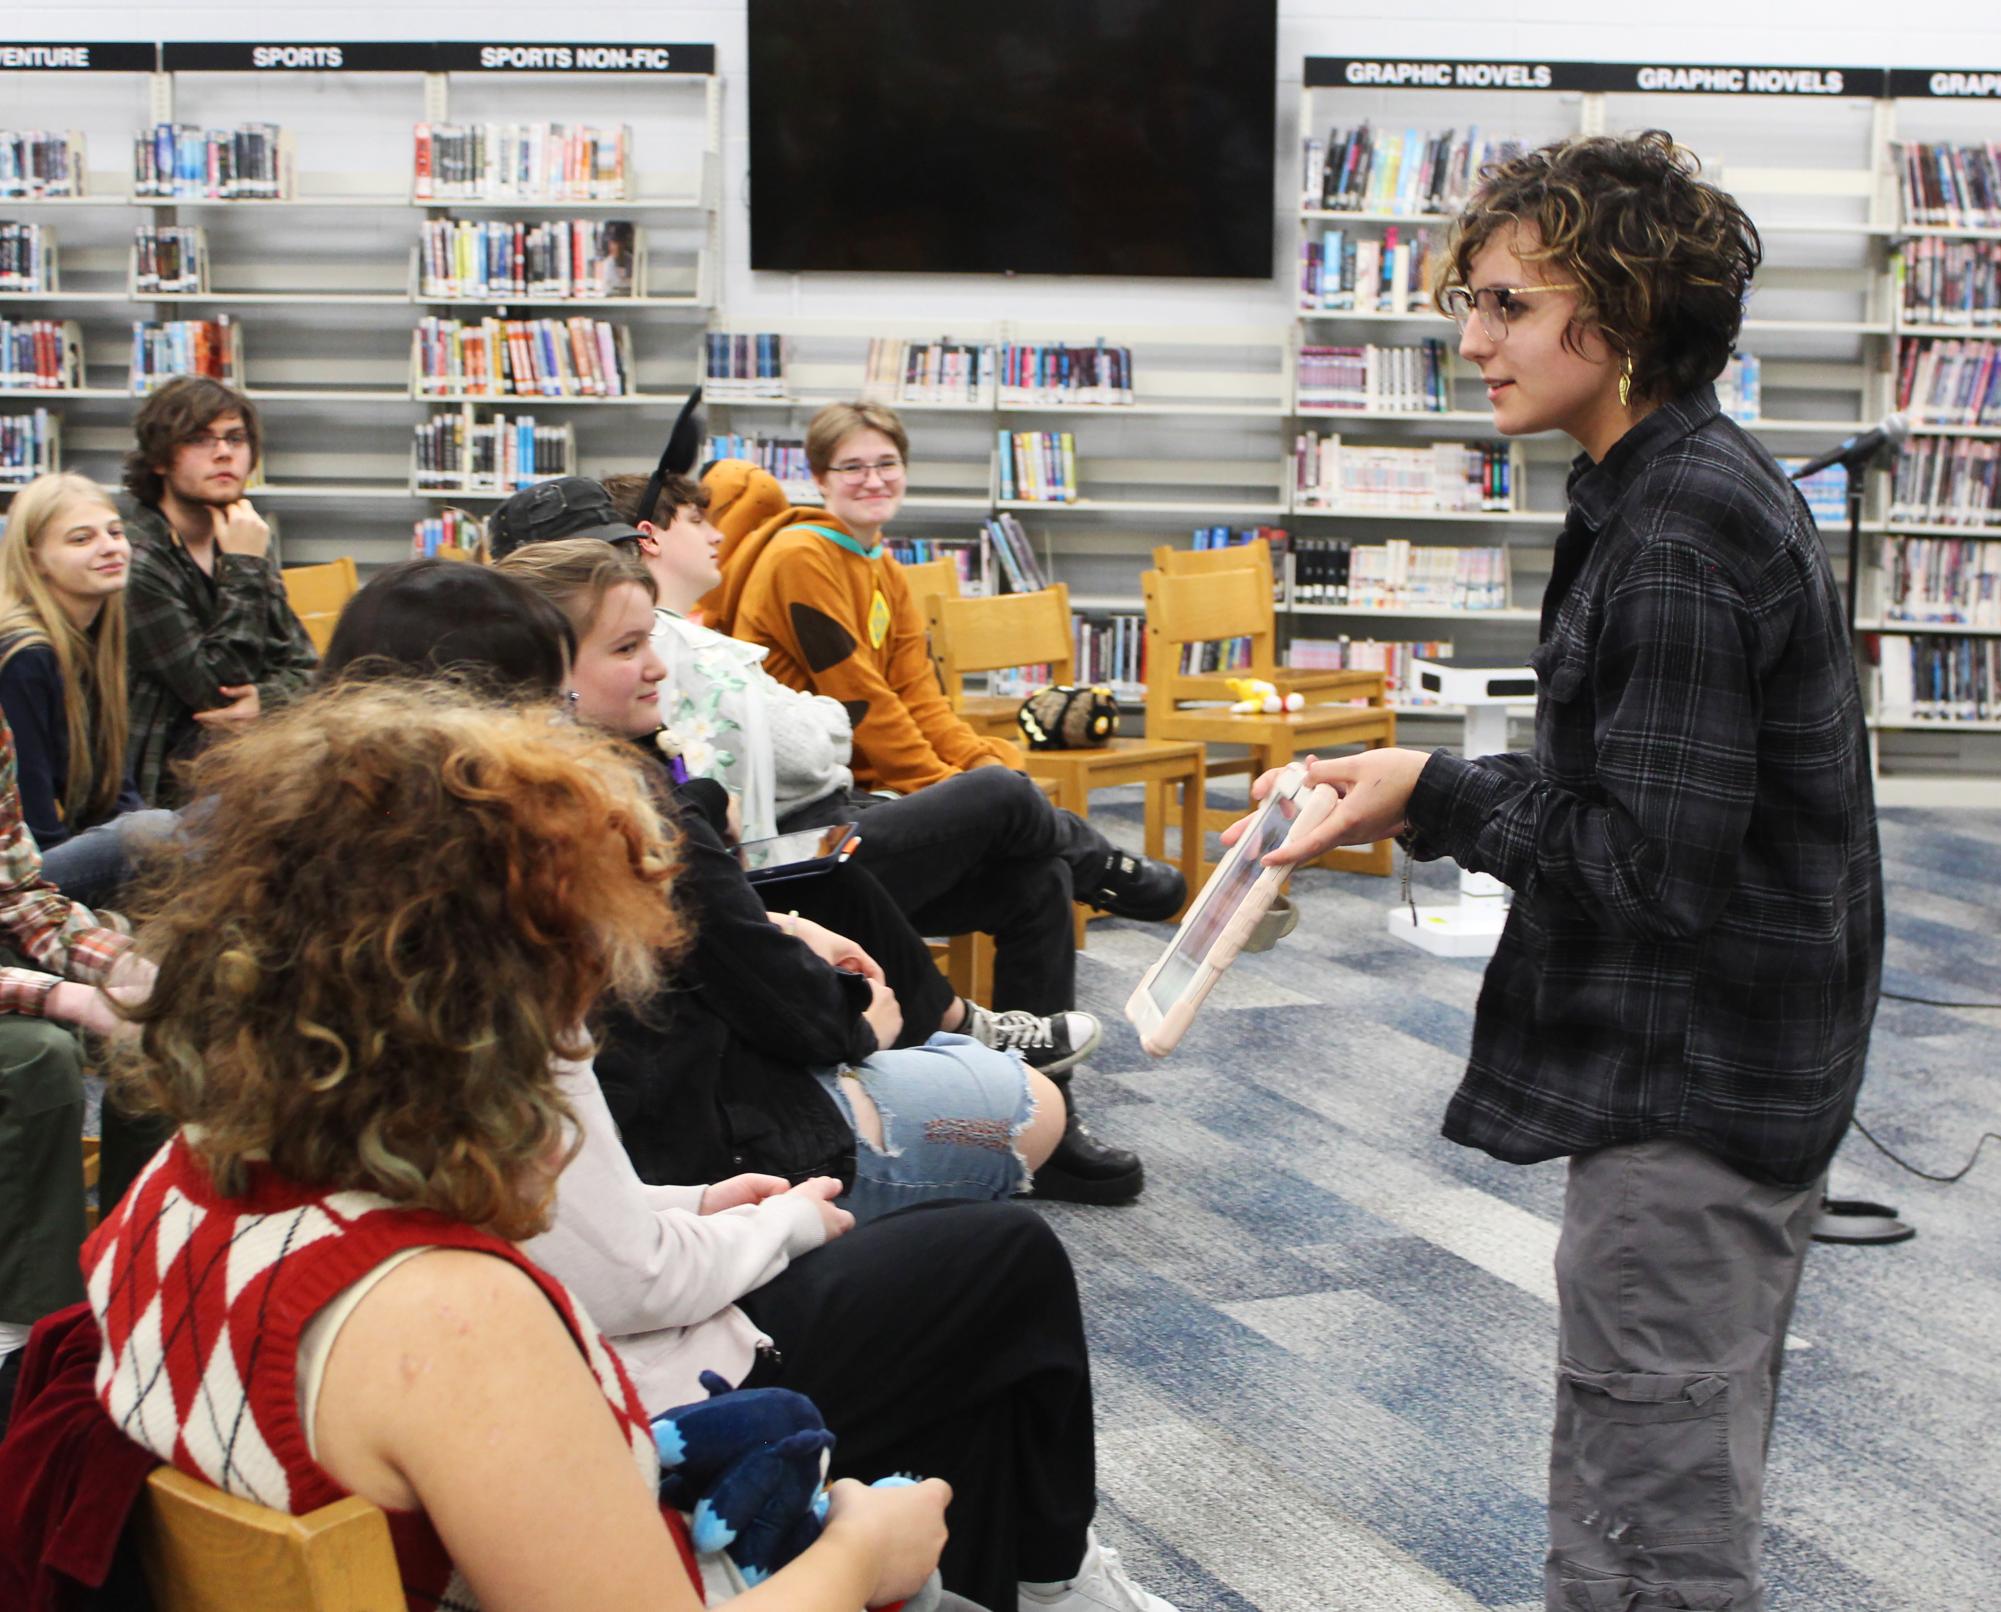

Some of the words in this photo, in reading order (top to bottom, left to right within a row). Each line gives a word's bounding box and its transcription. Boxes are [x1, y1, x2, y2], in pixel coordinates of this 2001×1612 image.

[252, 46, 343, 68] SPORTS
[480, 46, 573, 69] SPORTS
[576, 48, 669, 69] NON-FIC
[1345, 61, 1451, 86] GRAPHIC
[1456, 64, 1552, 87] NOVELS
[1636, 67, 1744, 91] GRAPHIC
[1747, 69, 1843, 93] NOVELS
